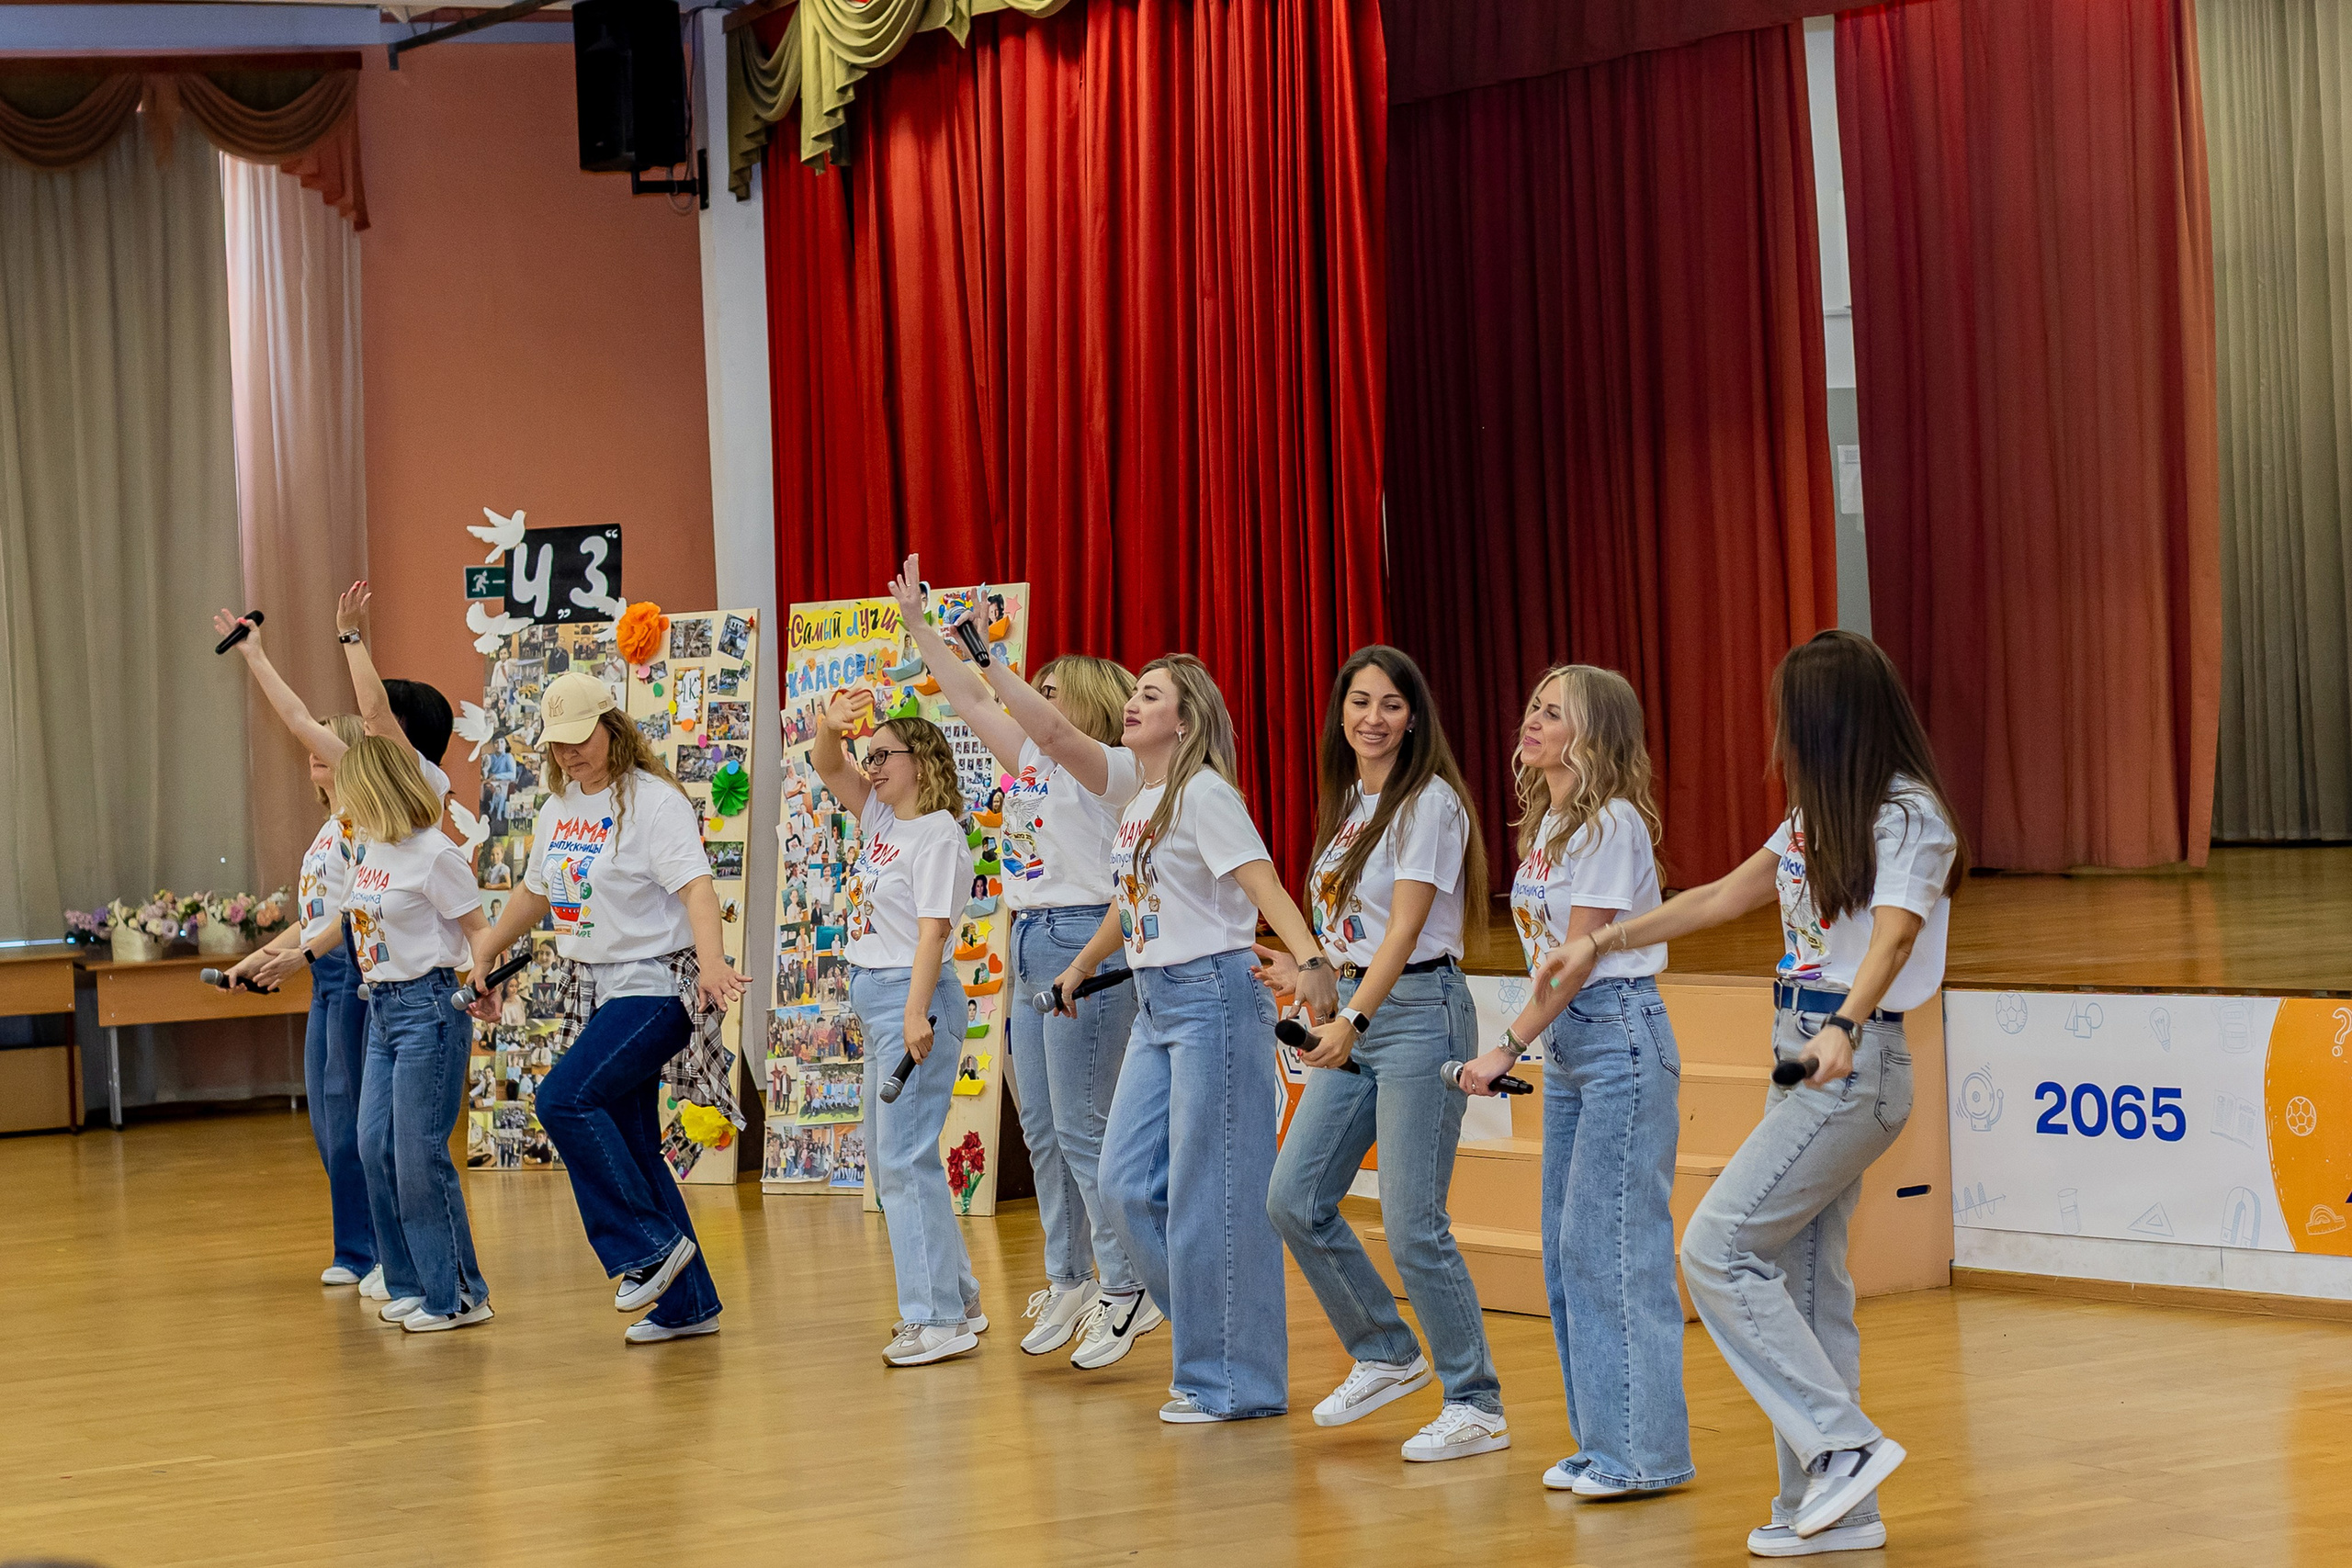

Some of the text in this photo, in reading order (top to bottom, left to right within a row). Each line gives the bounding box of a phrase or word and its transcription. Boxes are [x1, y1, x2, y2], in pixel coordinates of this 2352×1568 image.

[790, 606, 900, 649] Самый лучш
[552, 816, 608, 843] МАМА
[2034, 1080, 2188, 1143] 2065
